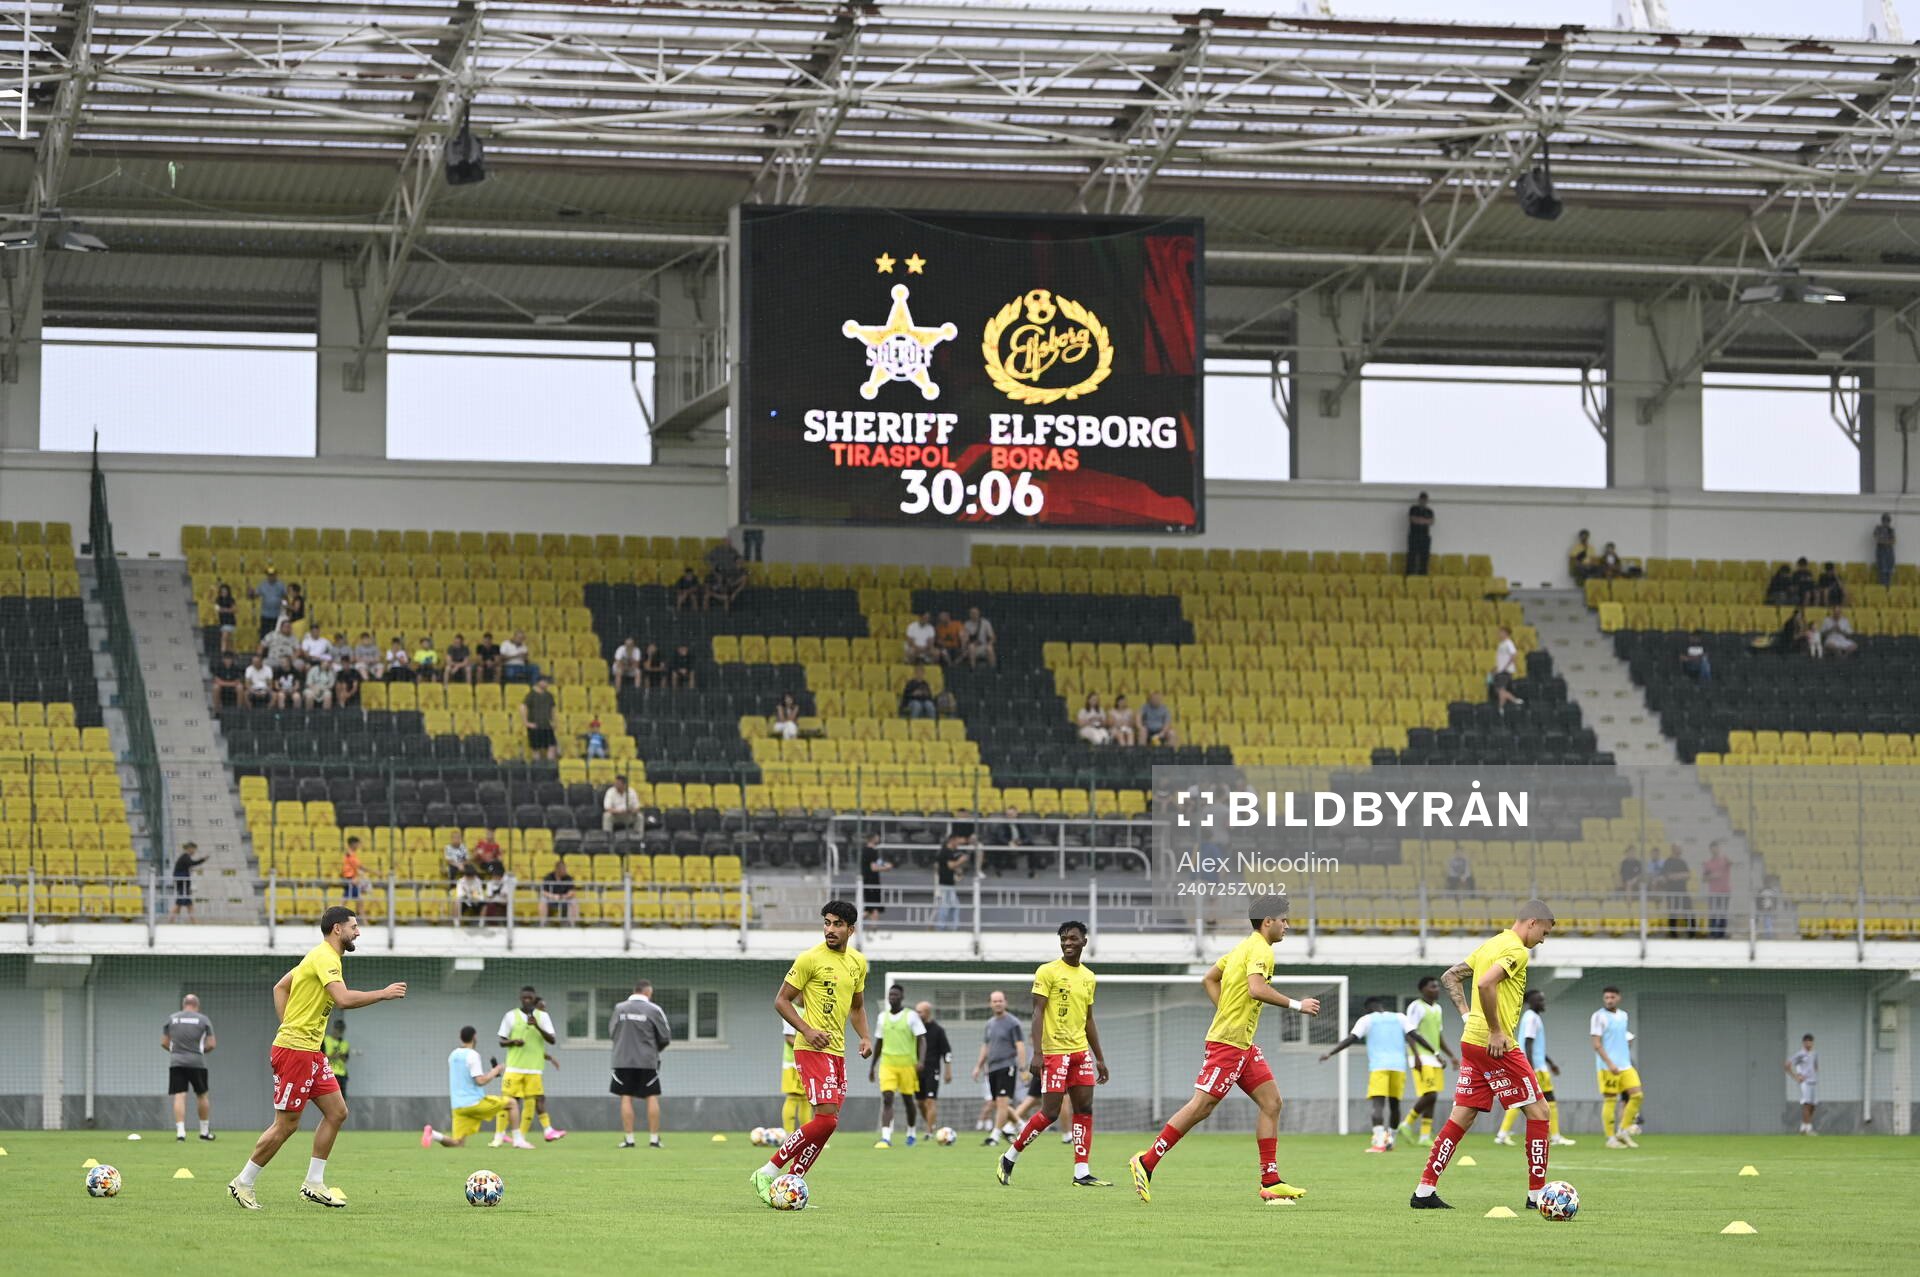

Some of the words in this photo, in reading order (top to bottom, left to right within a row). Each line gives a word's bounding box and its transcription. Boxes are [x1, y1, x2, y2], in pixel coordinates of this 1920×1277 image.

[804, 410, 957, 444] SHERIFF
[990, 414, 1177, 448] ELFSBORG
[830, 442, 956, 469] TIRASPOL
[991, 448, 1079, 471] BORAS
[900, 470, 1044, 515] 30:06
[1051, 1080, 1061, 1089] 14
[1217, 1083, 1230, 1094] 27
[1490, 1079, 1509, 1090] EAB
[821, 1089, 832, 1100] 18
[294, 1098, 302, 1108] 9
